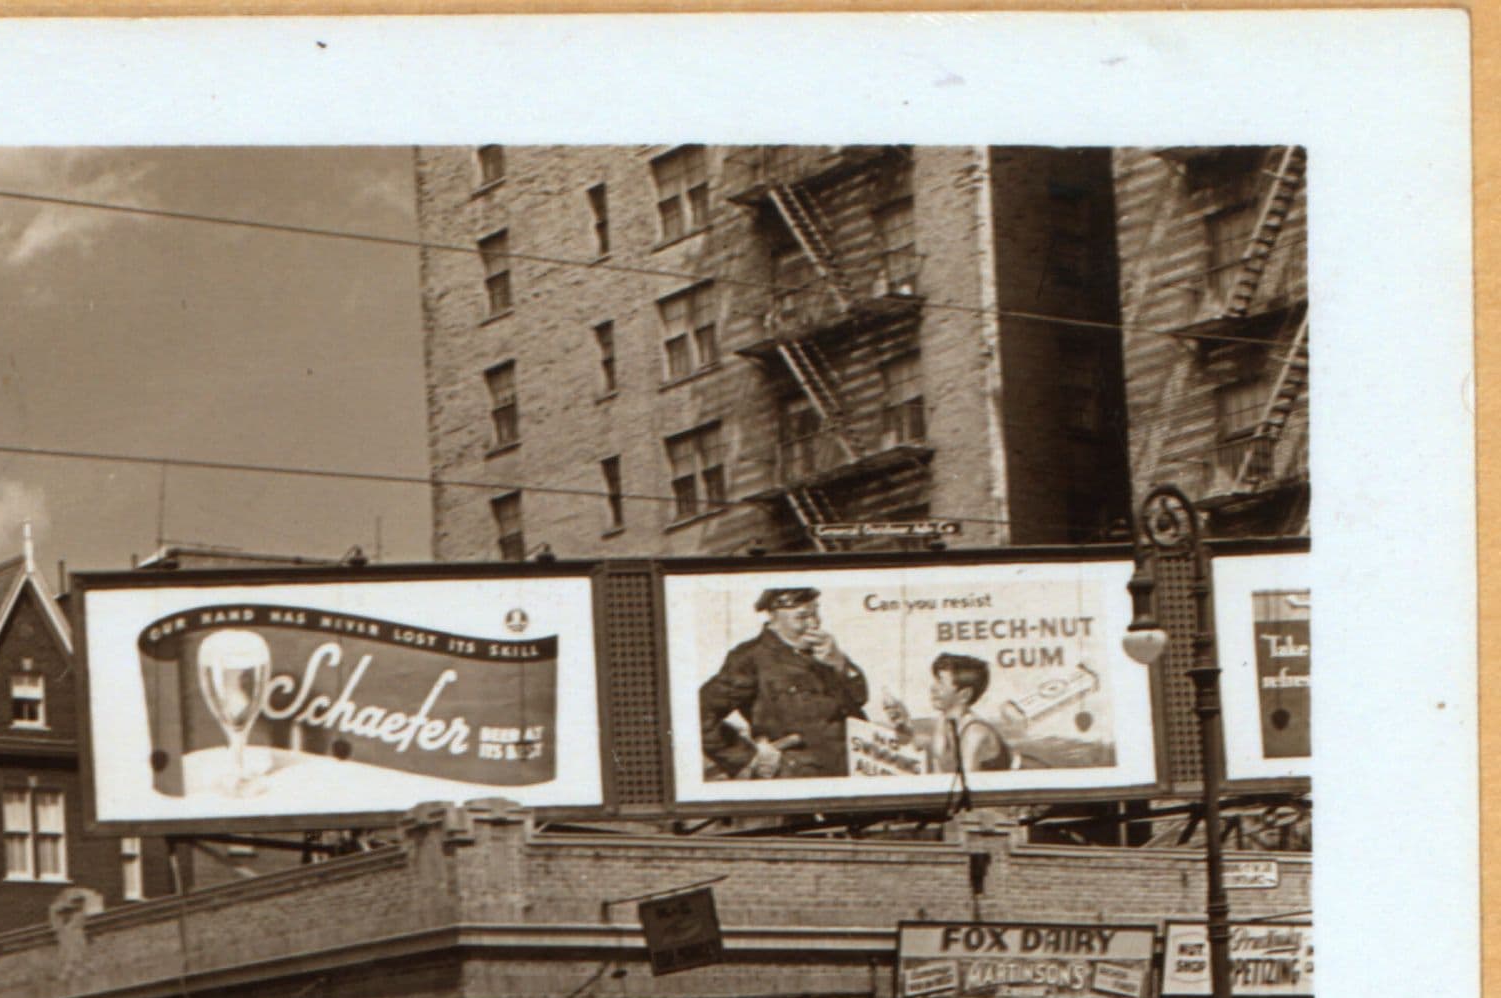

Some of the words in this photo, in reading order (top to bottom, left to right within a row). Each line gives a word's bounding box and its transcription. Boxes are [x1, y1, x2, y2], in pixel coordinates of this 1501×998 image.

[863, 593, 899, 613] Can
[904, 597, 937, 616] you
[942, 593, 993, 609] resist
[149, 616, 187, 642] OUR
[201, 608, 255, 625] HAND
[270, 610, 306, 625] HAS
[320, 615, 381, 637] NEVER
[394, 627, 437, 648] LOST
[450, 640, 476, 654] ITS
[489, 644, 540, 657] SKILL
[936, 616, 1095, 643] BEECH-NUT
[997, 647, 1066, 669] GUM
[262, 640, 469, 756] Schaefer
[480, 726, 520, 743] BEER
[523, 725, 545, 741] AT
[479, 742, 503, 760] ITS
[940, 926, 1008, 953] FOX
[1020, 927, 1116, 954] DAIRY
